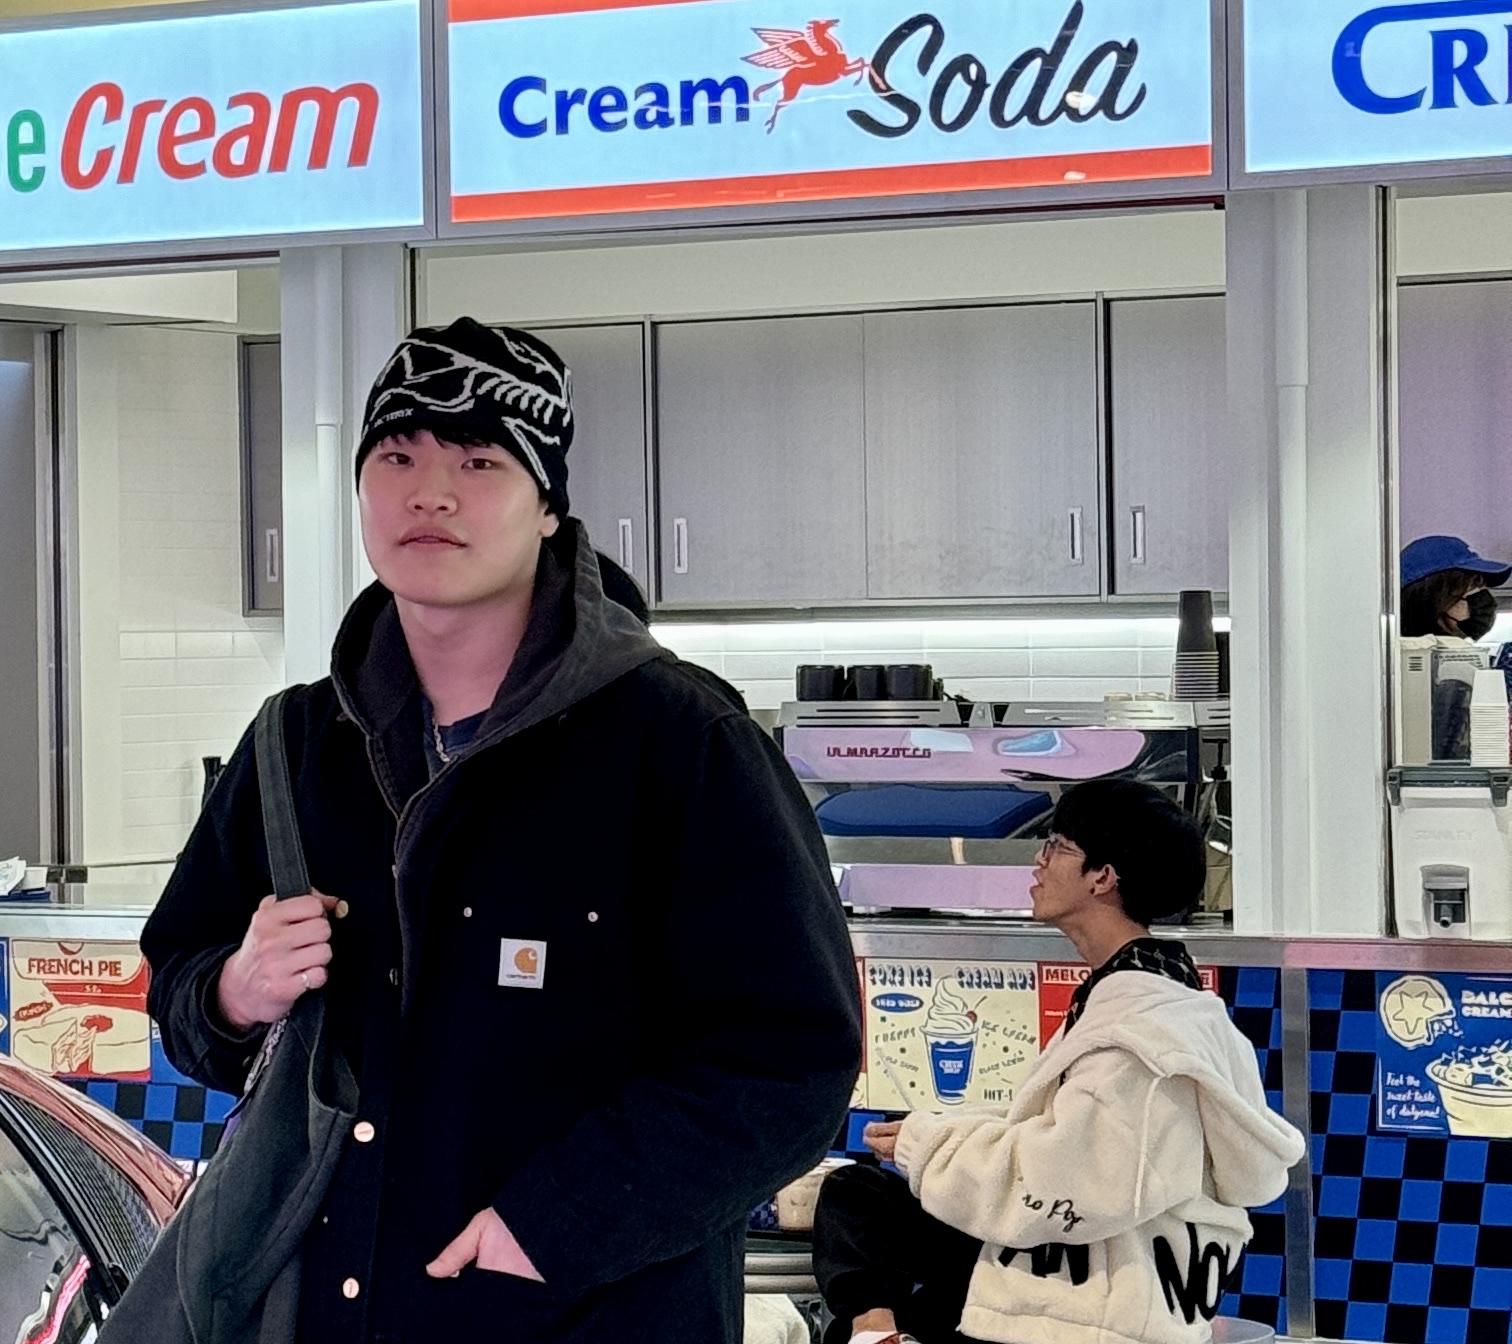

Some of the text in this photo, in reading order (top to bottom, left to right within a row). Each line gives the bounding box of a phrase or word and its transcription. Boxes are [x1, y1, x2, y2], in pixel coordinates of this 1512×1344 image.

[60, 81, 380, 191] Cream
[498, 71, 751, 140] Cream
[27, 958, 123, 977] FRENCH PIE
